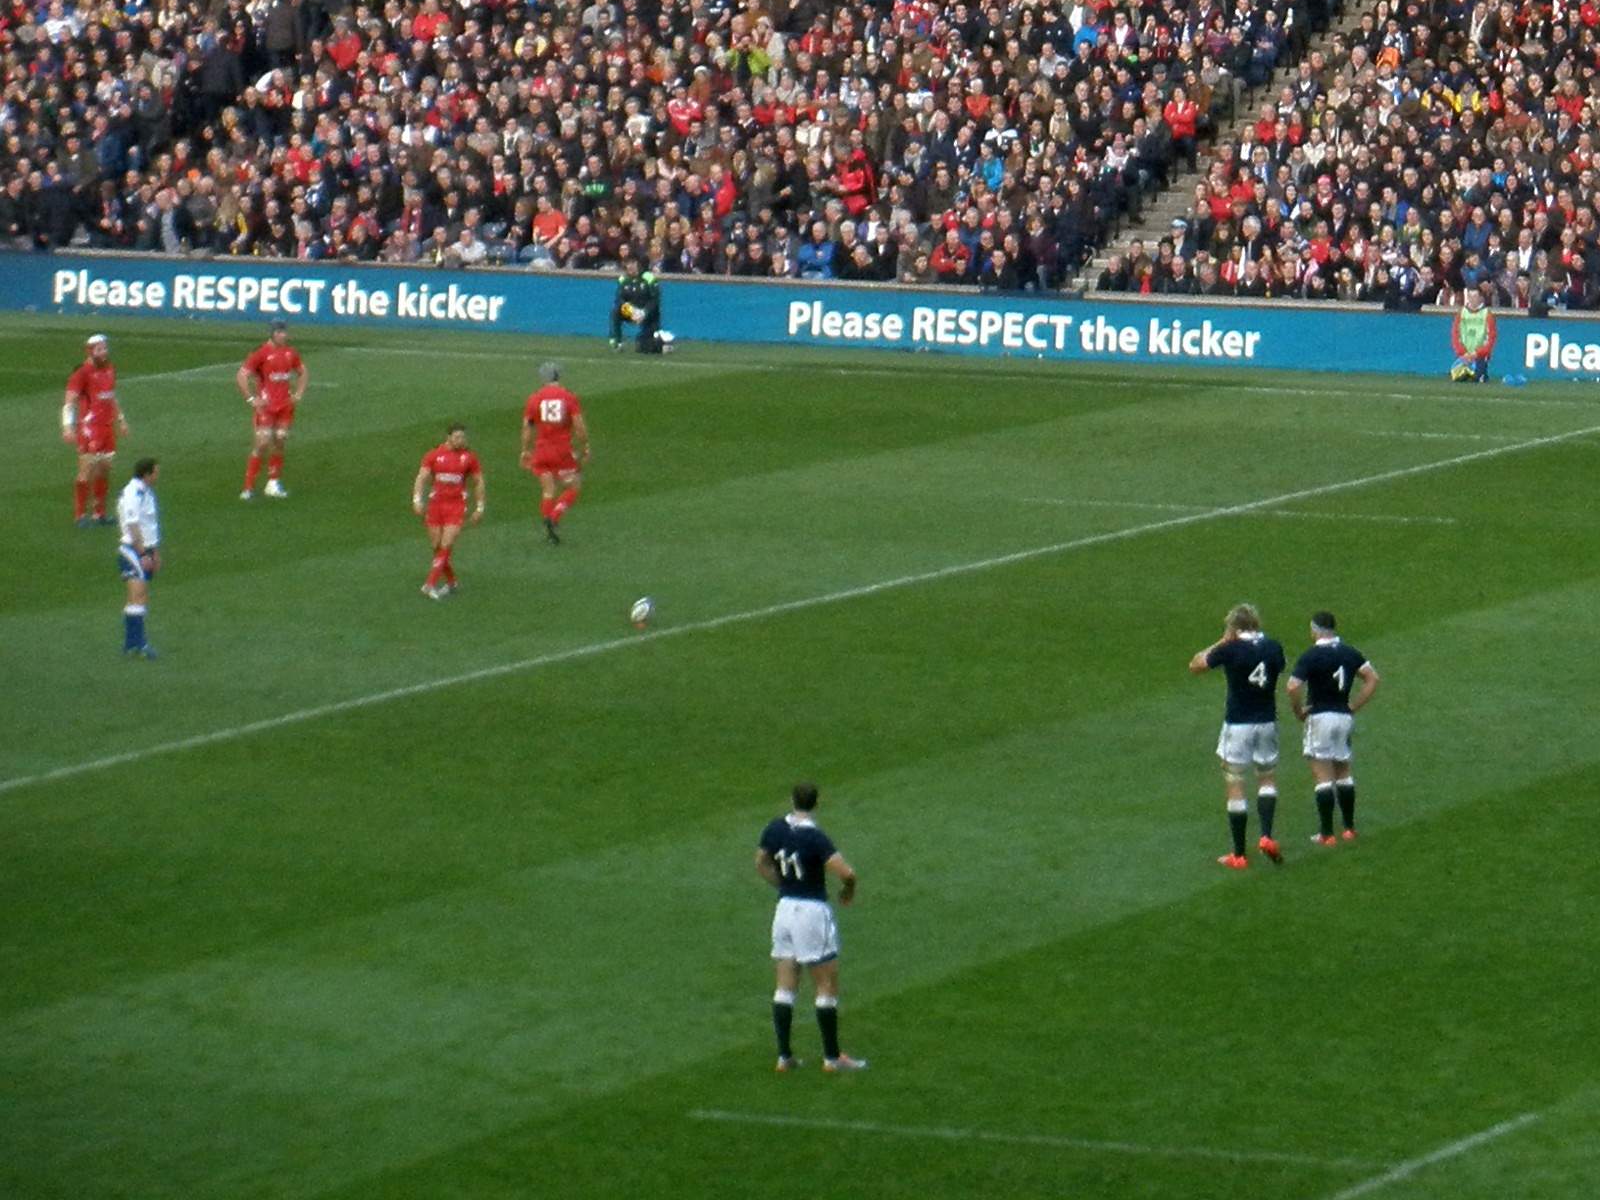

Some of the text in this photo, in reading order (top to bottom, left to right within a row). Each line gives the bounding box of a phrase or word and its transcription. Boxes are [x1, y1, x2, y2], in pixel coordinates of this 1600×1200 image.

[54, 269, 504, 322] Please RESPECT the kicker
[789, 300, 1260, 358] Please RESPECT the kicker
[540, 399, 562, 421] 13
[1248, 661, 1268, 688] 4
[1332, 665, 1346, 692] 1
[774, 848, 802, 879] 11
